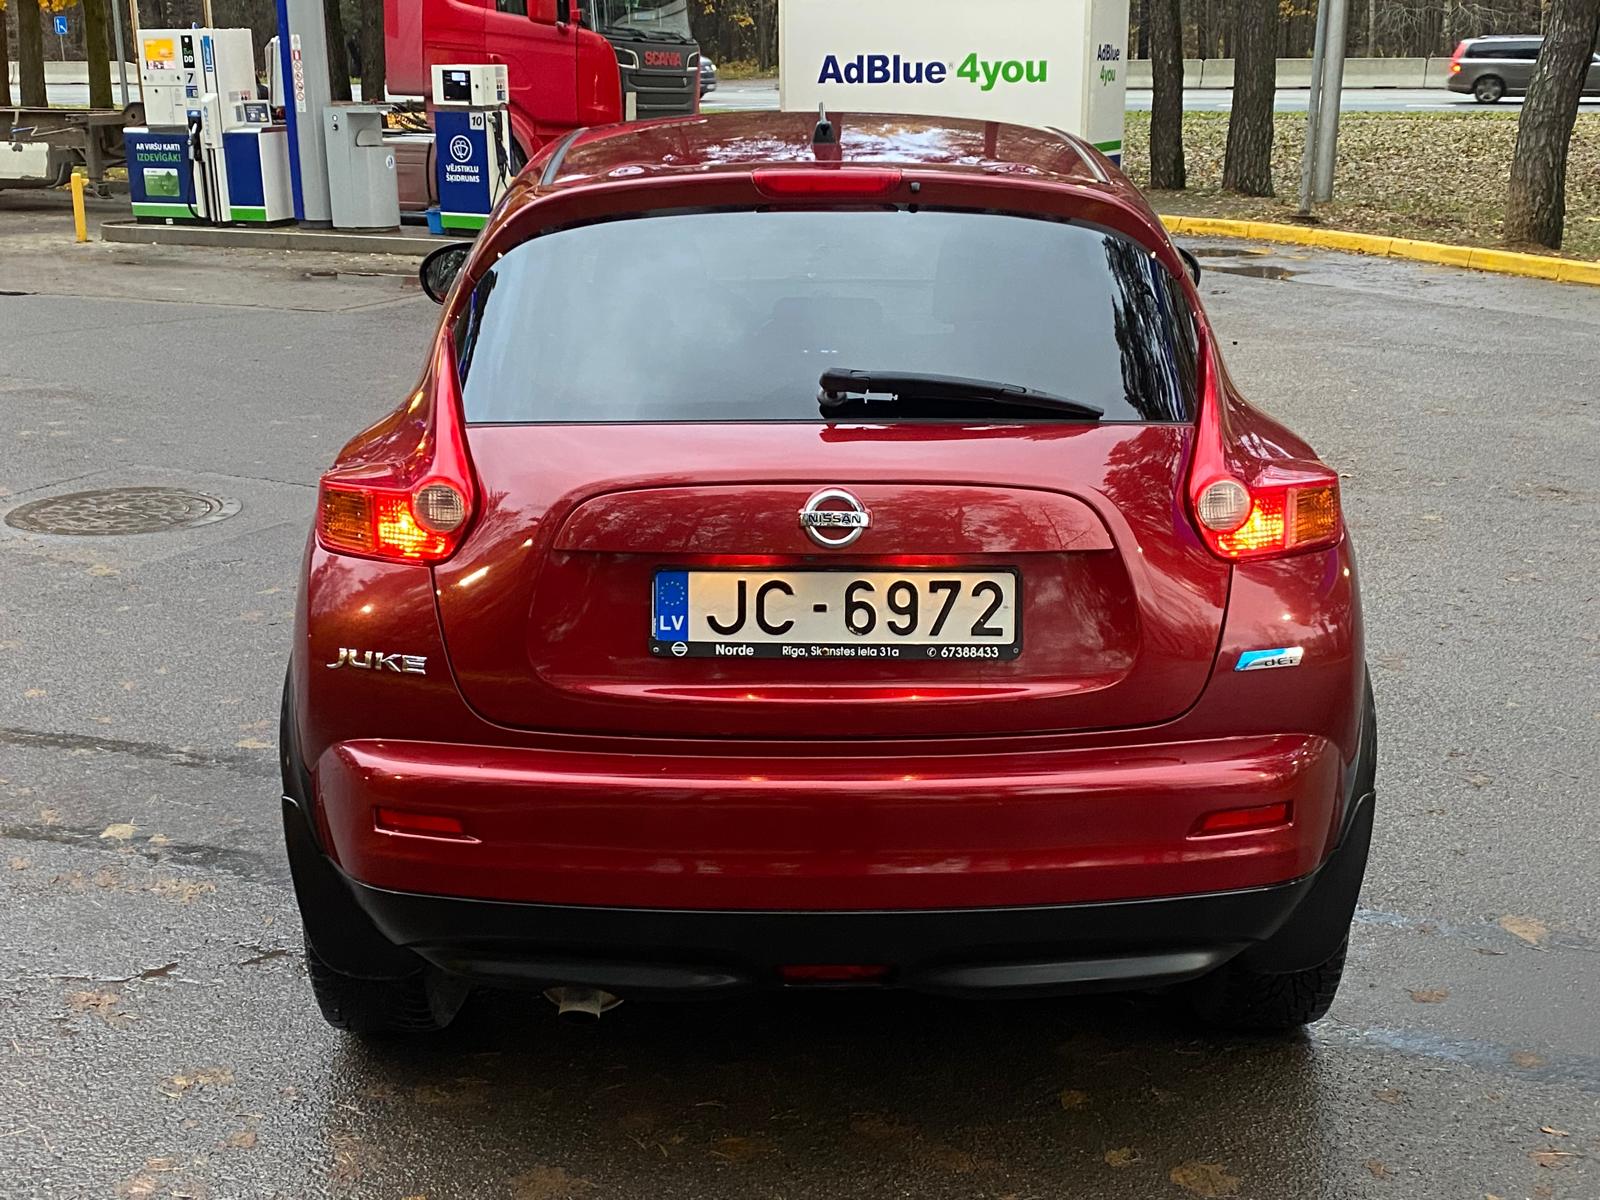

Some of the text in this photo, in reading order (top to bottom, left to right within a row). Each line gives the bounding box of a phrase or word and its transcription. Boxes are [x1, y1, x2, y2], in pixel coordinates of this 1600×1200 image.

[1097, 44, 1120, 61] AdBlue
[644, 51, 682, 66] SCANIA
[817, 52, 1048, 91] AdBlue 4you
[1100, 65, 1116, 86] 4you
[187, 73, 194, 83] 7
[471, 116, 482, 126] 10
[163, 143, 180, 151] KARTI
[445, 163, 479, 173] VĒJSTIKLU
[446, 172, 480, 183] ŠĶIDRUMS
[808, 513, 861, 523] NISSAN
[659, 615, 684, 631] LV
[715, 644, 754, 656] Norde
[811, 646, 855, 656] Skanstes
[857, 647, 877, 657] iela
[879, 647, 899, 657] 31a
[941, 647, 999, 658] 67388433
[326, 647, 428, 675] JUKE
